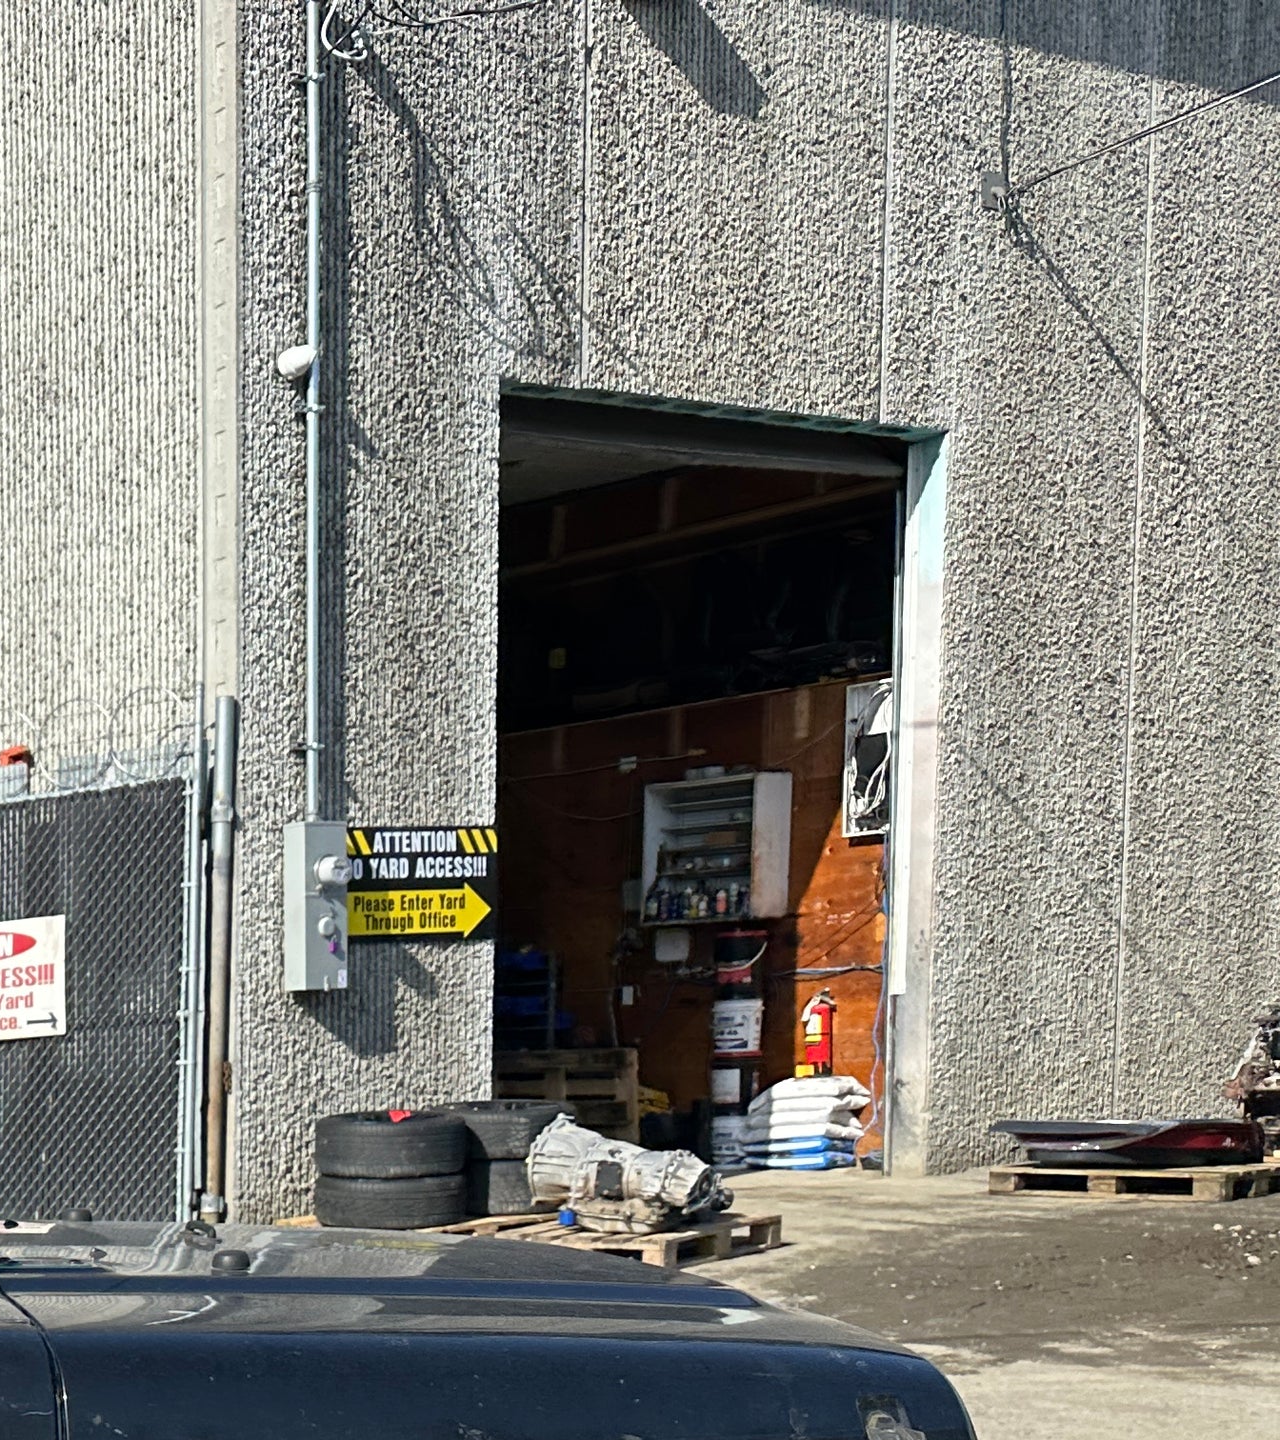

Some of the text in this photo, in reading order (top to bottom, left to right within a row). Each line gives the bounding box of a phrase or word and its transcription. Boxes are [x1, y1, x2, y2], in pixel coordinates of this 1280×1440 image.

[373, 830, 457, 853] ATTENTION
[369, 857, 409, 879] YARD
[415, 856, 487, 879] ACCESS!!!
[354, 893, 465, 912] Please Enter Yard
[364, 911, 456, 931] Through Office
